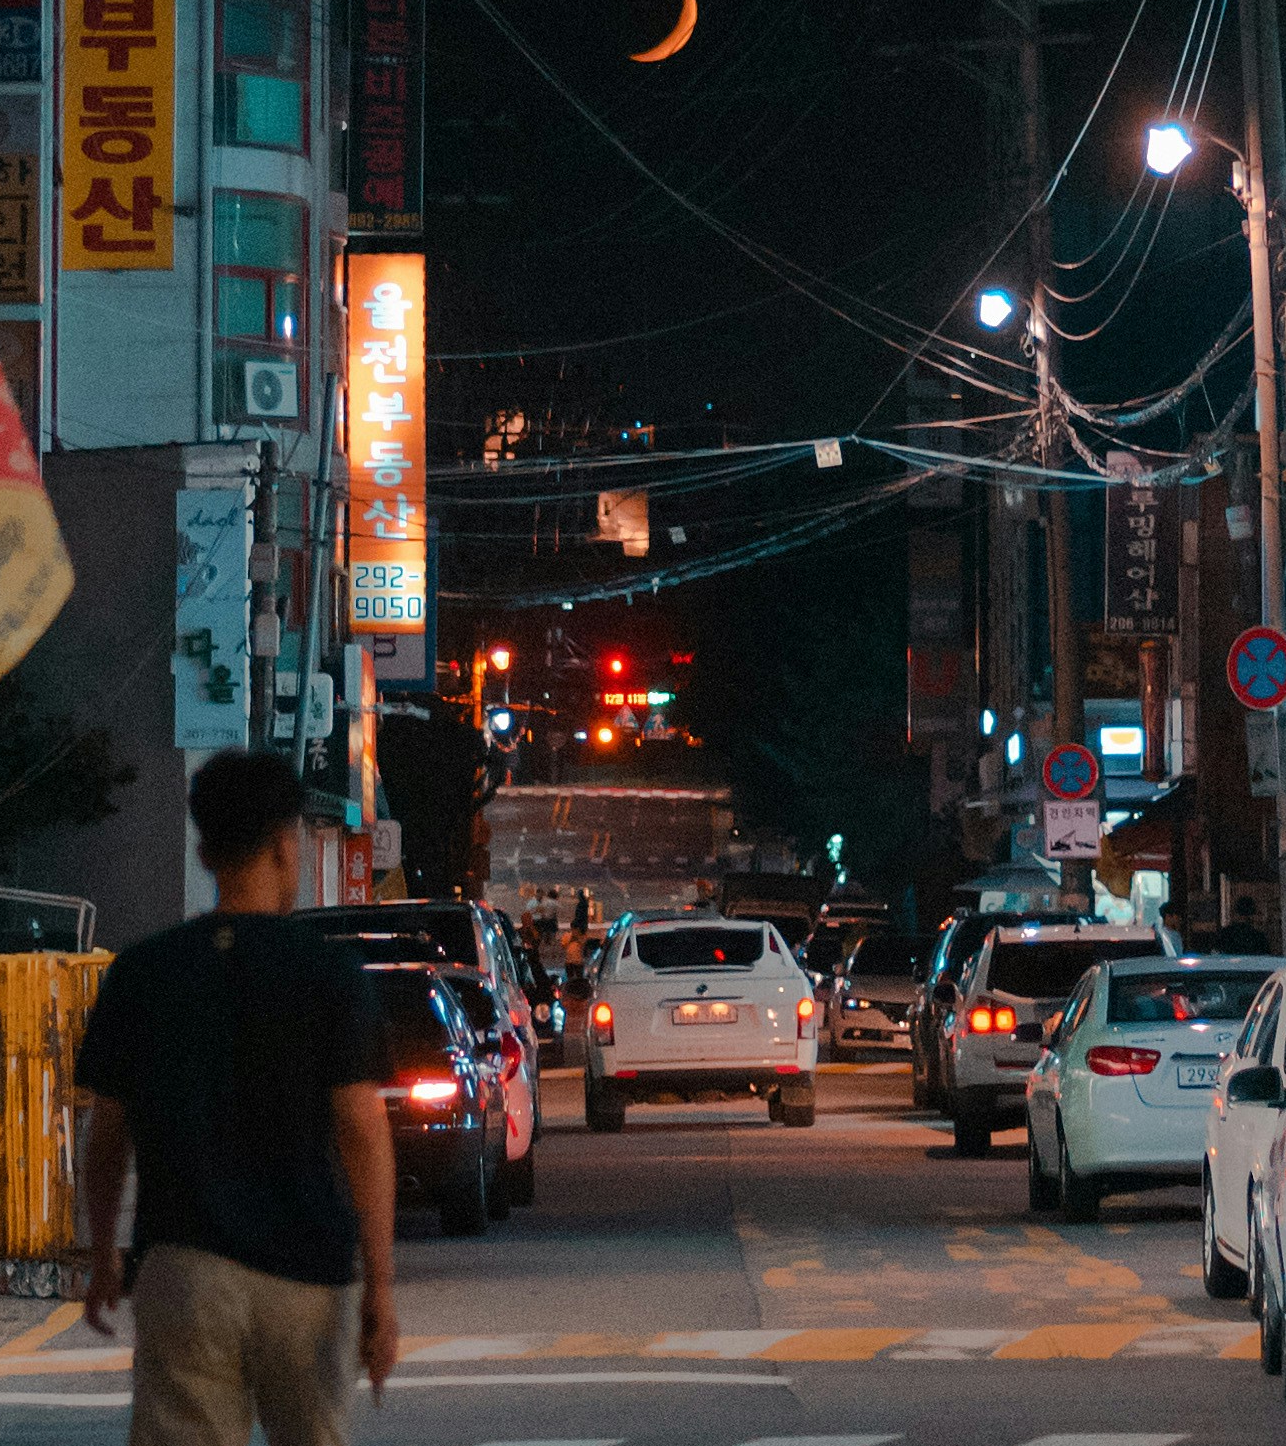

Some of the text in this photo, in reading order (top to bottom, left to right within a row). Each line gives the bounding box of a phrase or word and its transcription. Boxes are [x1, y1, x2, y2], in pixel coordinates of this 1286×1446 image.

[359, 280, 417, 543] 율전부동산
[354, 565, 420, 590] 292-
[354, 596, 423, 621] 9050
